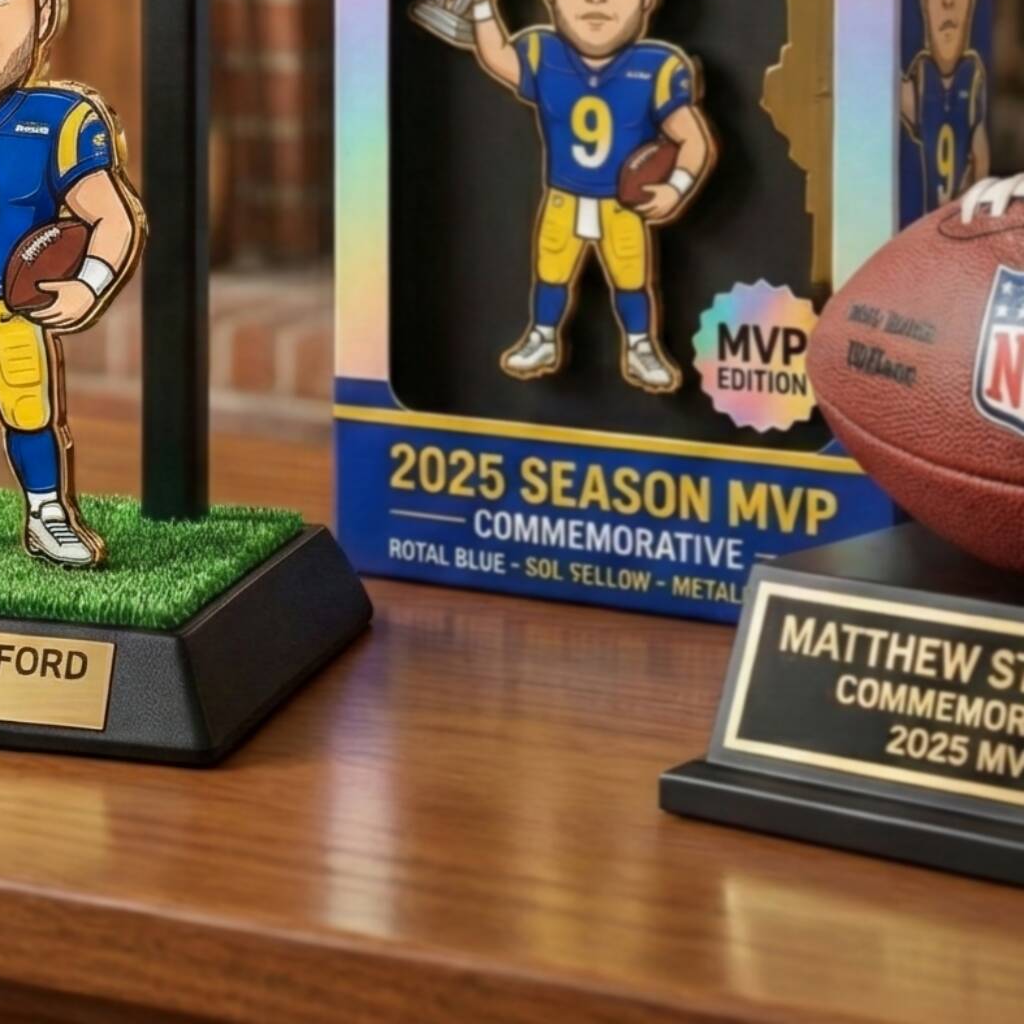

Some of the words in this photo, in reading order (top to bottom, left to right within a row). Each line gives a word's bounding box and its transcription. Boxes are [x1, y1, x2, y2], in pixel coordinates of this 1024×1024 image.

[571, 96, 614, 169] 9
[717, 322, 808, 365] MVP
[717, 367, 808, 395] EDITION
[389, 443, 506, 500] 2025
[520, 456, 711, 524] SEASON
[729, 481, 838, 536] MVP
[455, 547, 507, 574] BLUE
[474, 509, 745, 570] COMMEMORATIVE
[780, 614, 983, 684] MATTHEW
[886, 725, 970, 766] 2025
